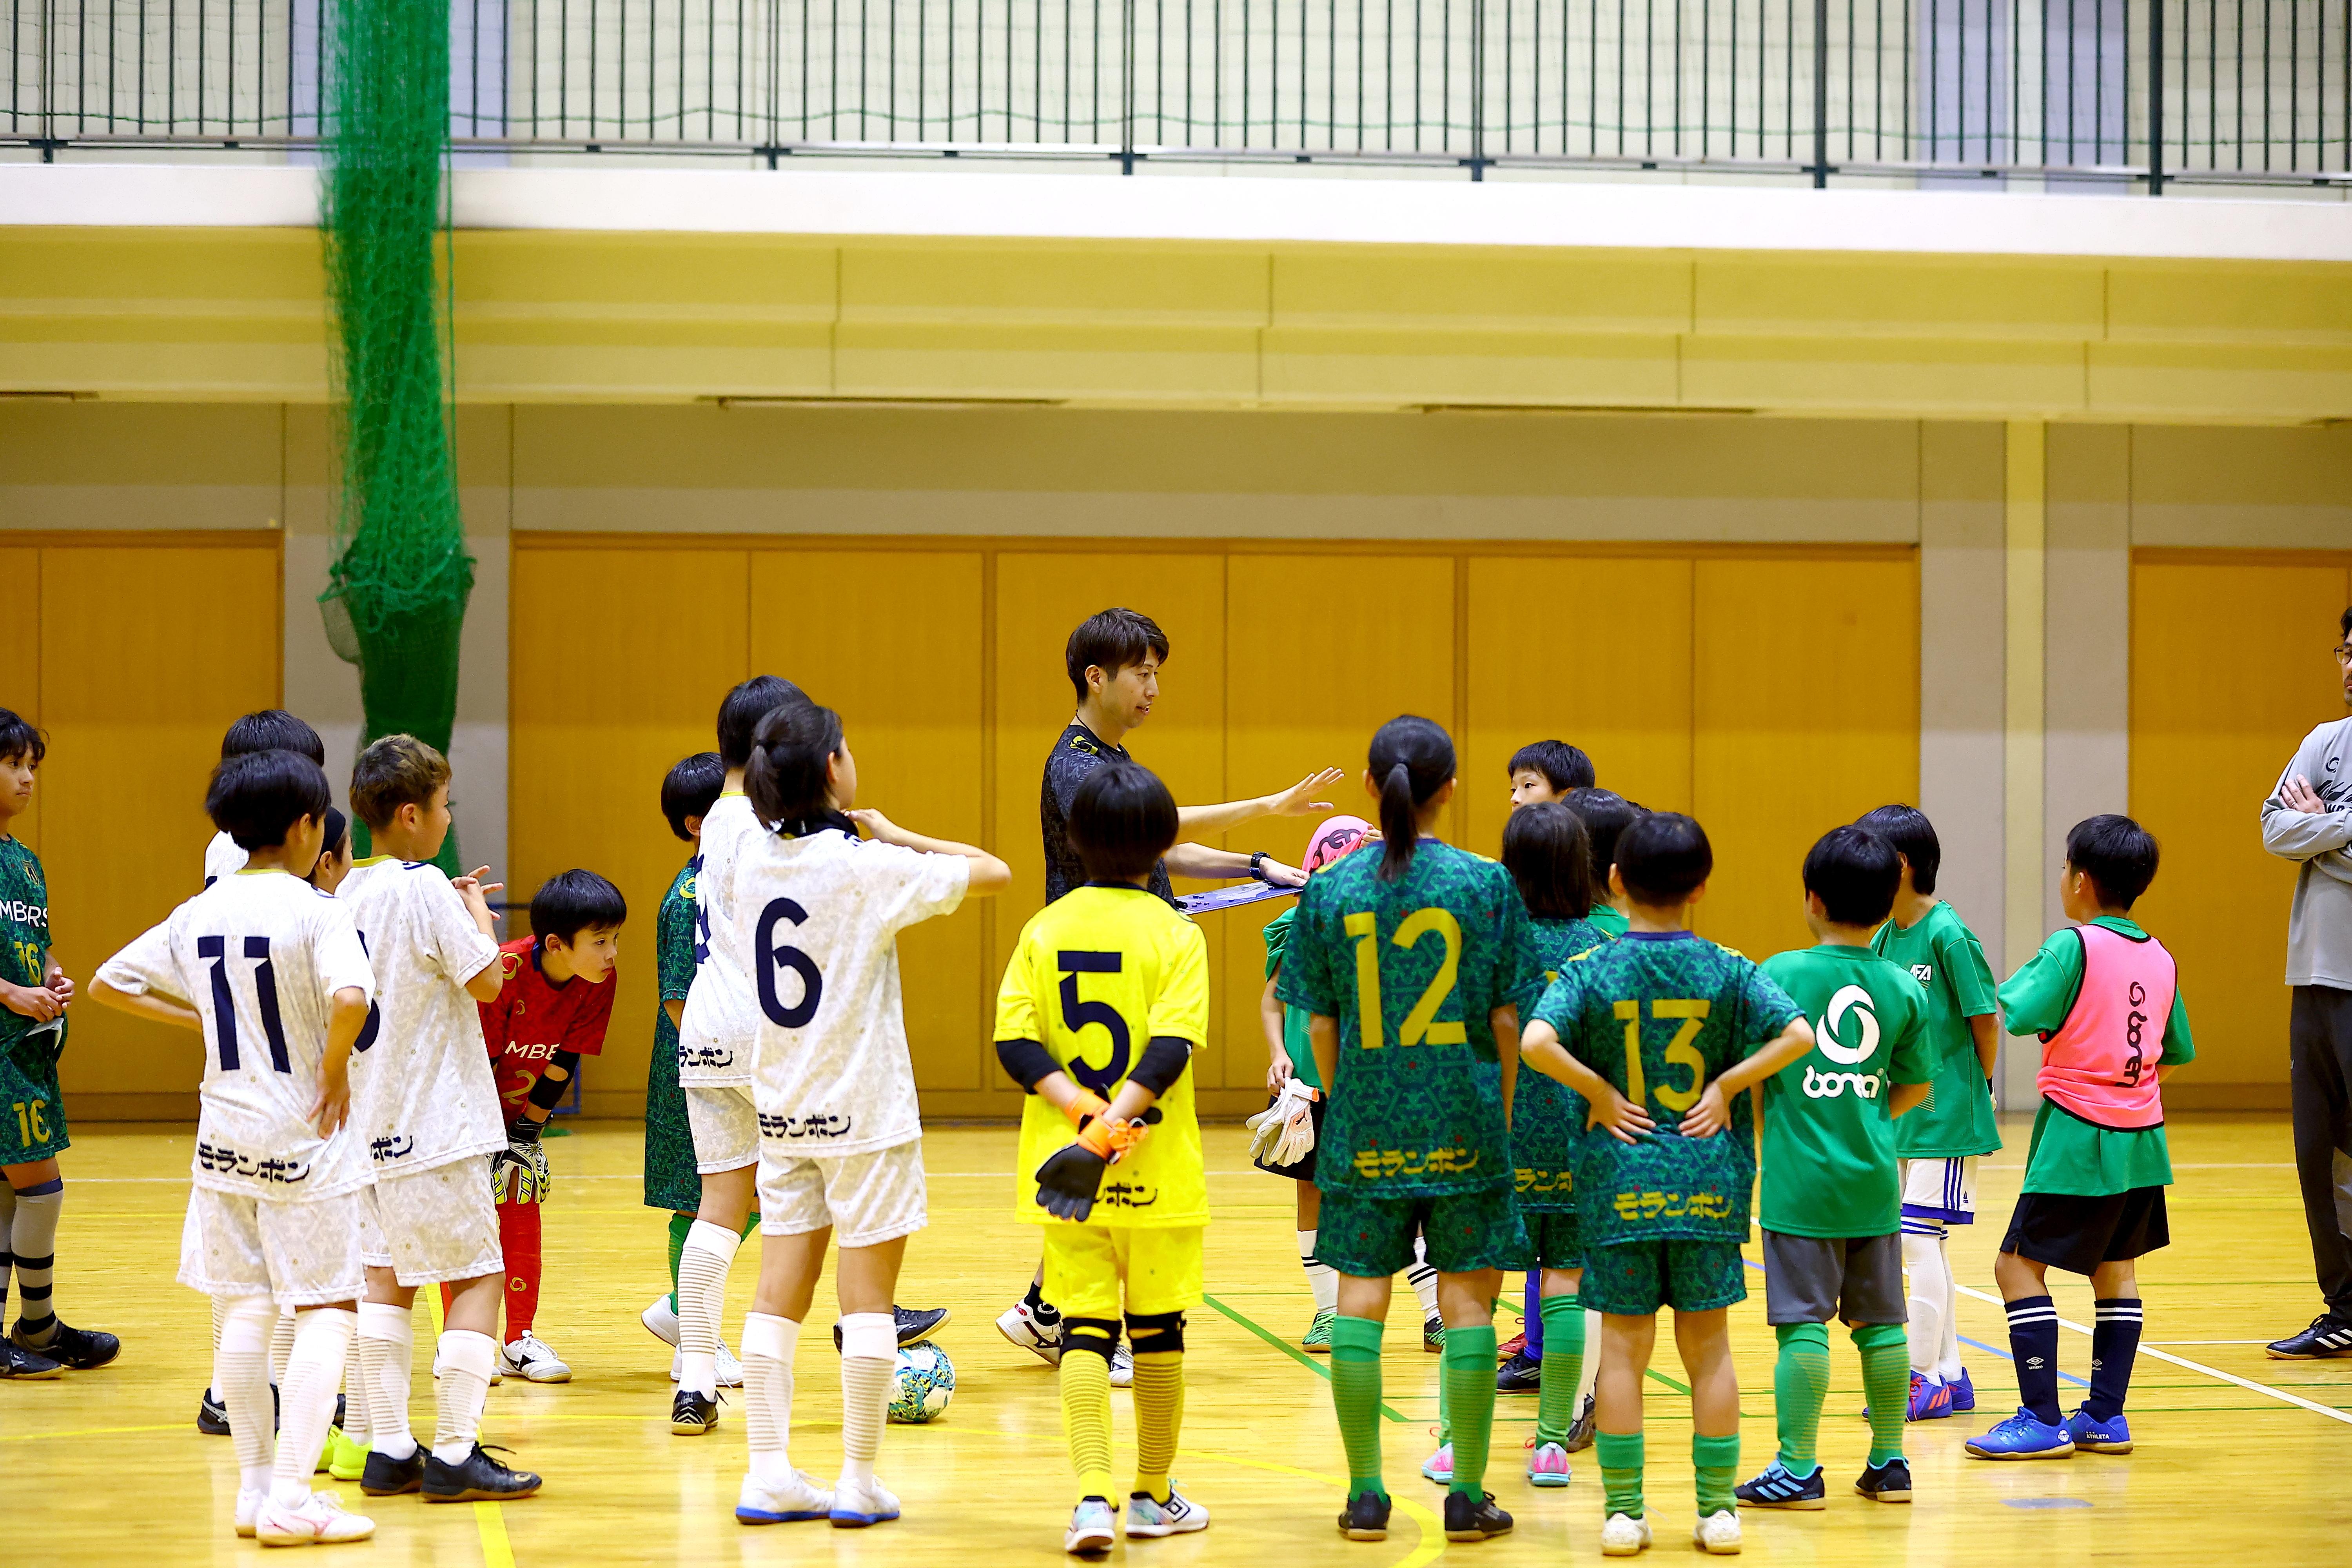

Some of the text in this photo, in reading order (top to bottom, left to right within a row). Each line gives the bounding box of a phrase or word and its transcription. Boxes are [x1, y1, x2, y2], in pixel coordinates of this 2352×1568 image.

[14, 941, 41, 986] 16
[756, 898, 822, 1028] 6
[1344, 907, 1466, 1049] 12
[198, 936, 291, 1074] 11
[1058, 951, 1130, 1094] 5
[1613, 999, 1710, 1111] 13
[13, 1099, 51, 1147] 16
[758, 1112, 850, 1138] モランボン
[199, 1142, 310, 1183] モランボン
[1354, 1147, 1478, 1178] モランボン
[1614, 1191, 1733, 1220] モランボン
